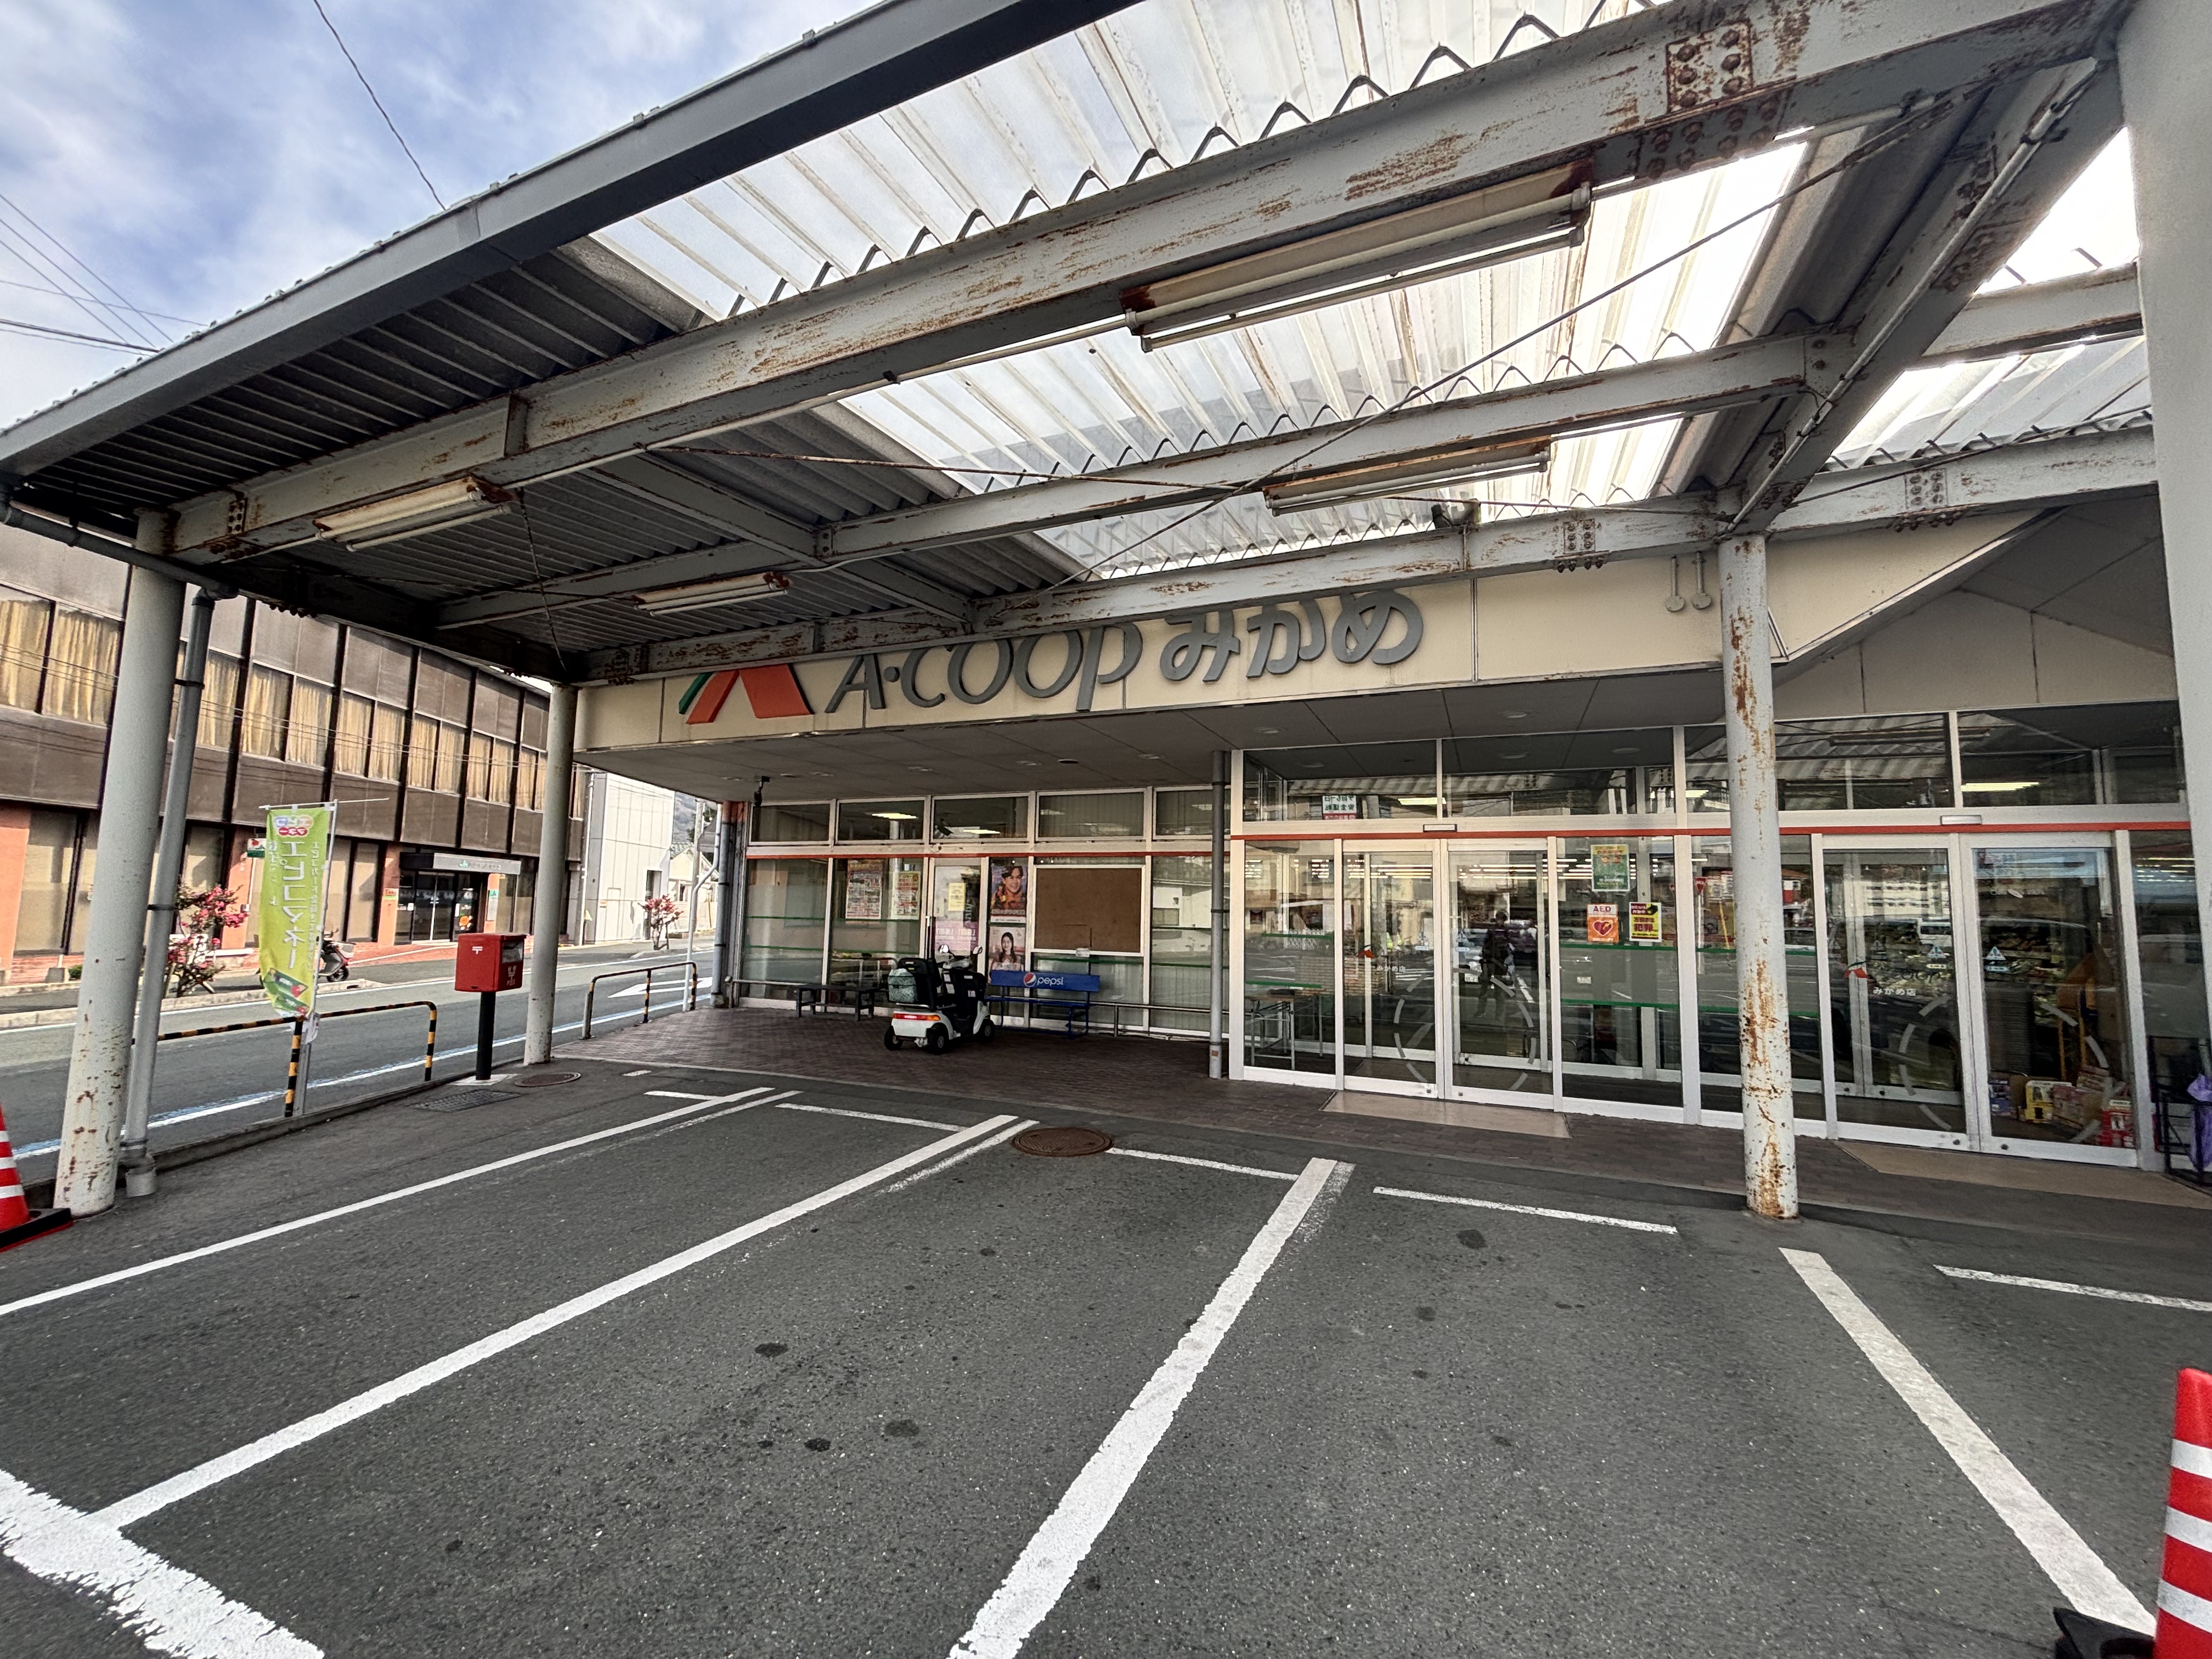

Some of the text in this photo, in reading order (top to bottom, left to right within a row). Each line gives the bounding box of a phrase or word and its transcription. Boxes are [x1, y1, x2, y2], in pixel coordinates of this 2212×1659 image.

[1159, 590, 1424, 682] みかめ
[1037, 977, 1064, 986] pepsi
[1872, 987, 1917, 997] みかめ店
